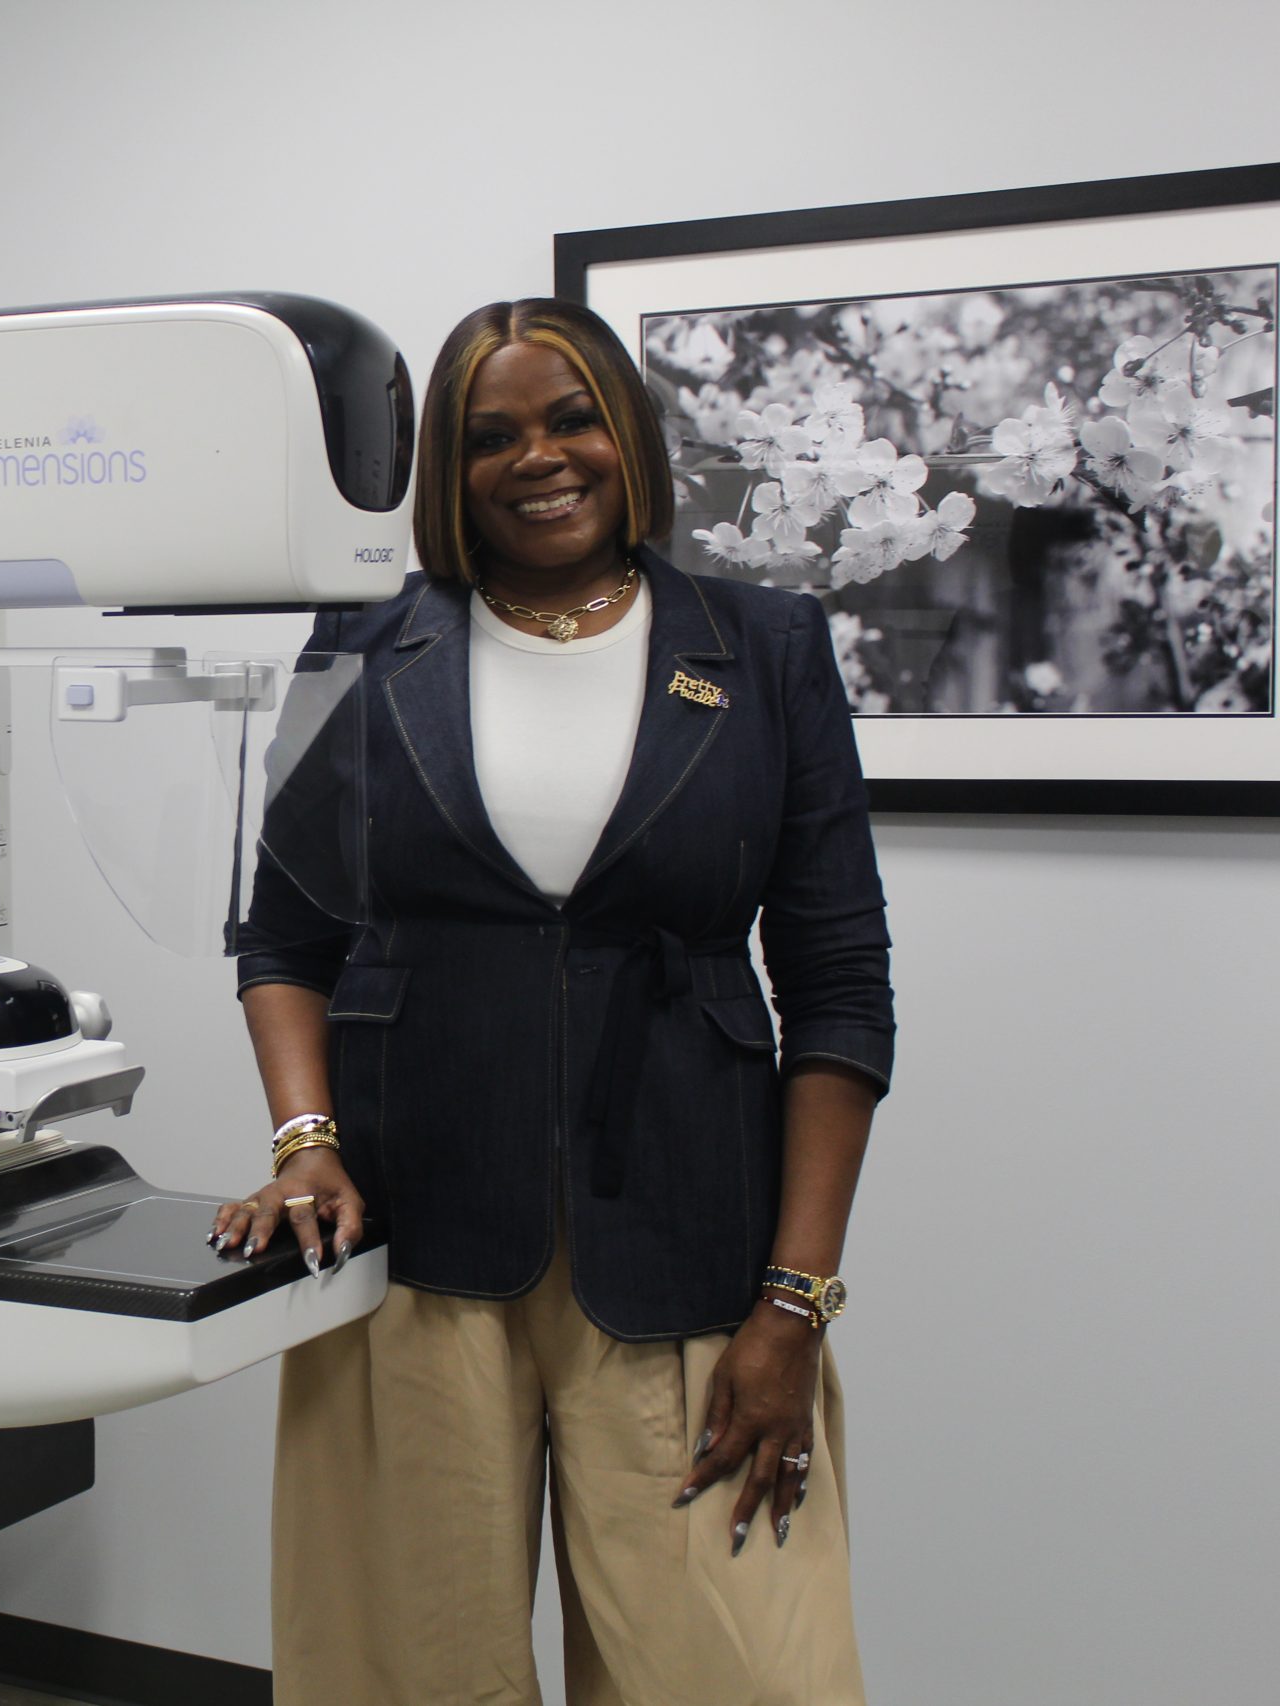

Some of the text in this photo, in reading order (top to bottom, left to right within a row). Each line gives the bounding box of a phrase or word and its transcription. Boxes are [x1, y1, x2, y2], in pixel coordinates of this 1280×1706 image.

[355, 548, 395, 563] HOLOGIC
[668, 682, 717, 707] Poodle
[672, 670, 724, 698] Pretty
